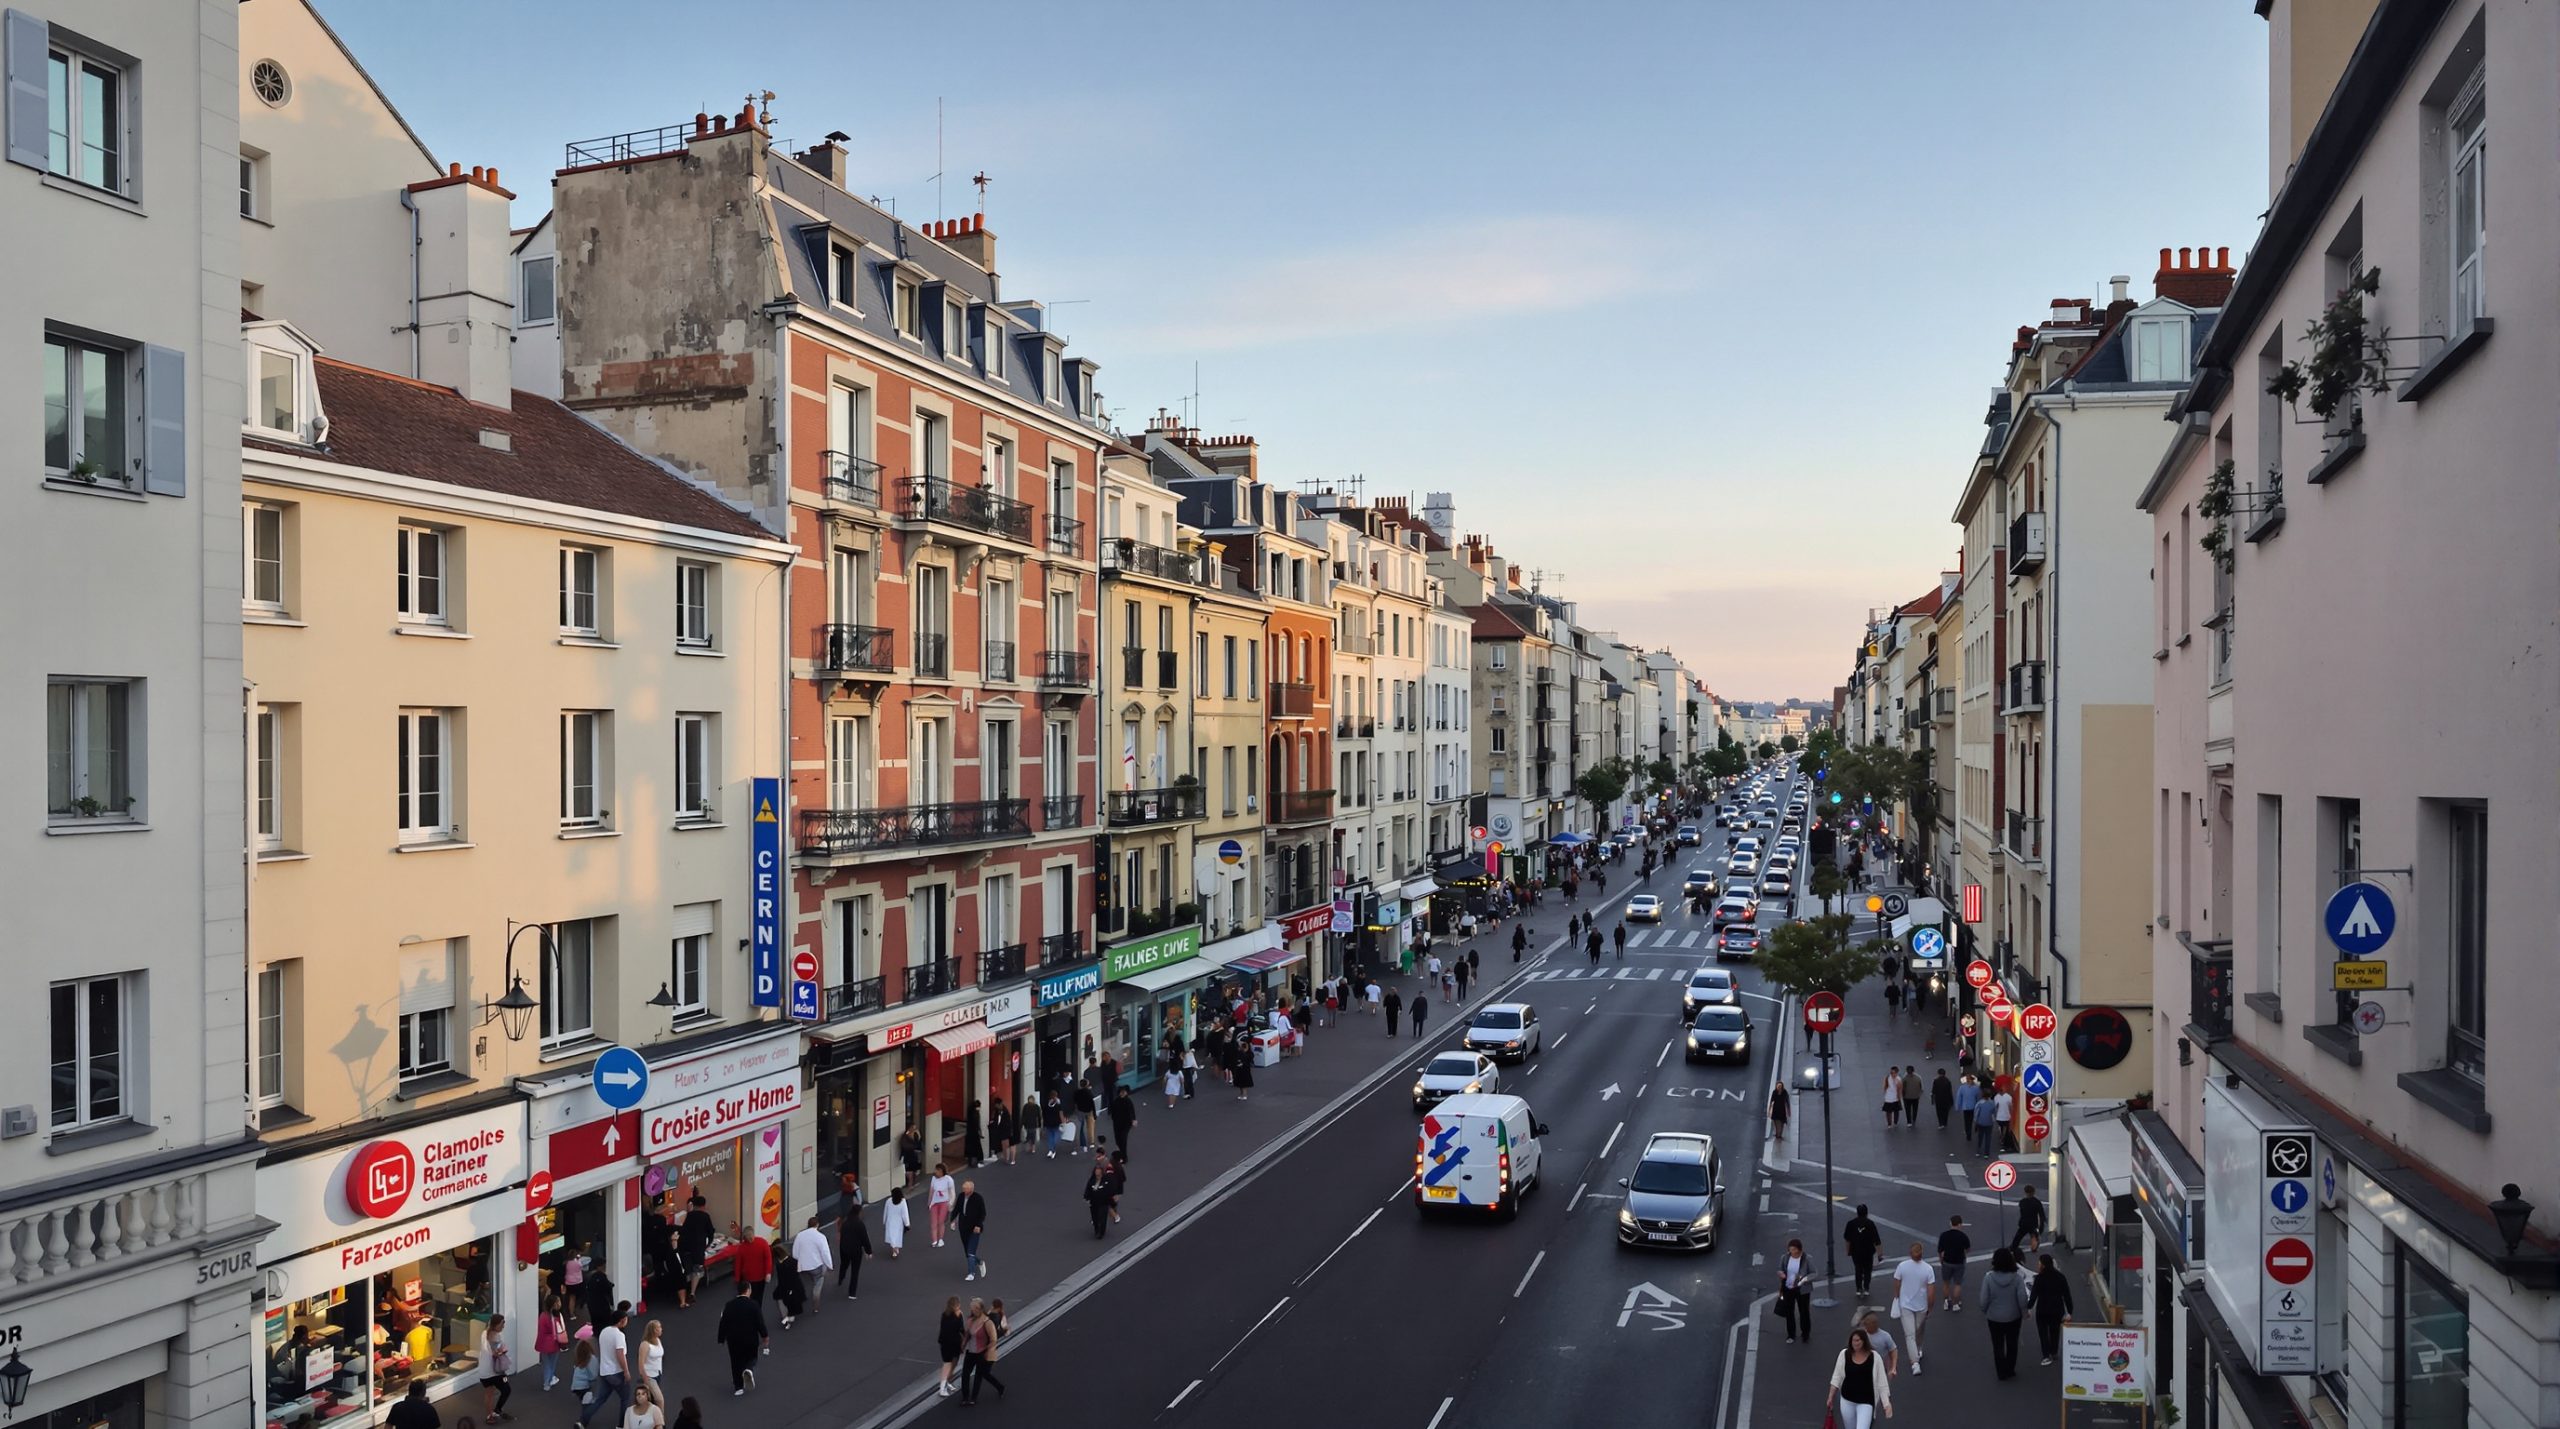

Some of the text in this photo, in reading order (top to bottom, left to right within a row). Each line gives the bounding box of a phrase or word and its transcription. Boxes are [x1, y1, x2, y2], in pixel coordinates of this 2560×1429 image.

[757, 850, 773, 994] CERNID
[715, 1098, 744, 1125] Sur
[342, 1226, 431, 1270] Farzocom
